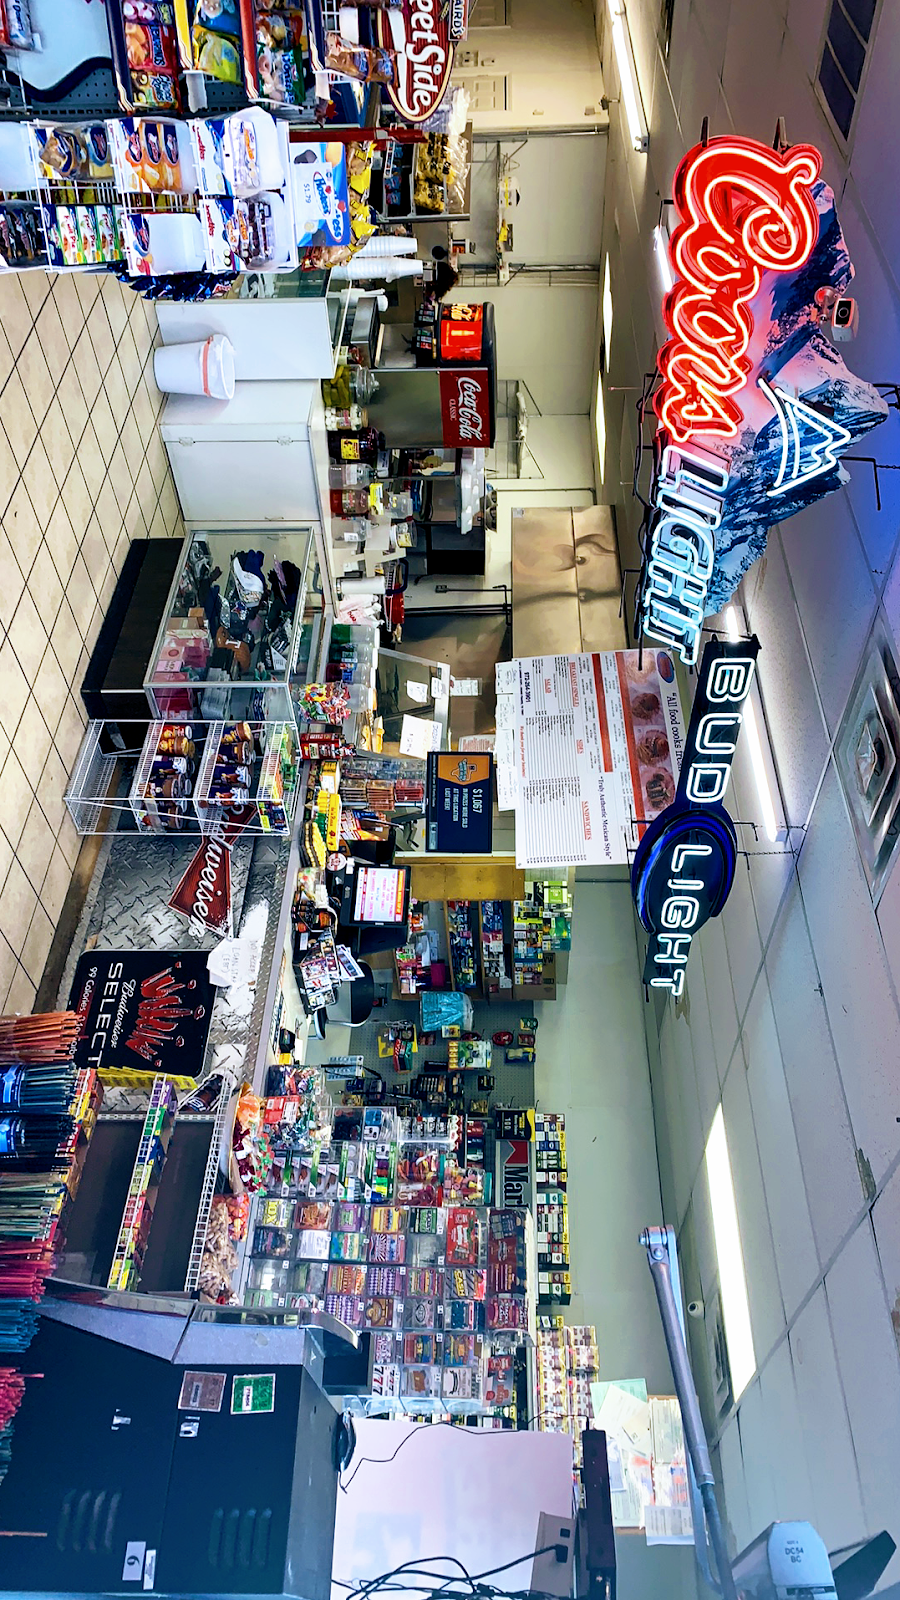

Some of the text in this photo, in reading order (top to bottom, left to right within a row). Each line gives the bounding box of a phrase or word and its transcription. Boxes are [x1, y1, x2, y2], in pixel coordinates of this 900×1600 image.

[406, 43, 445, 106] Side
[313, 178, 330, 214] Hostess
[449, 399, 457, 421] CLASSIC
[458, 377, 482, 442] Coca-Cola
[642, 135, 823, 666] Coors LIGHT
[225, 639, 242, 649] T
[668, 709, 680, 725] food
[670, 727, 682, 749] cooks
[472, 789, 482, 814] $1,067
[599, 793, 607, 818] Authentic
[583, 801, 592, 841] SANDWICHES
[647, 657, 757, 996] BUD LIGHT
[88, 967, 98, 978] 99
[88, 962, 123, 1067] SELECT
[110, 978, 136, 1049] Budweiser
[265, 1200, 279, 1224] 10X
[456, 1270, 465, 1297] CASH
[127, 1555, 140, 1566] 6
